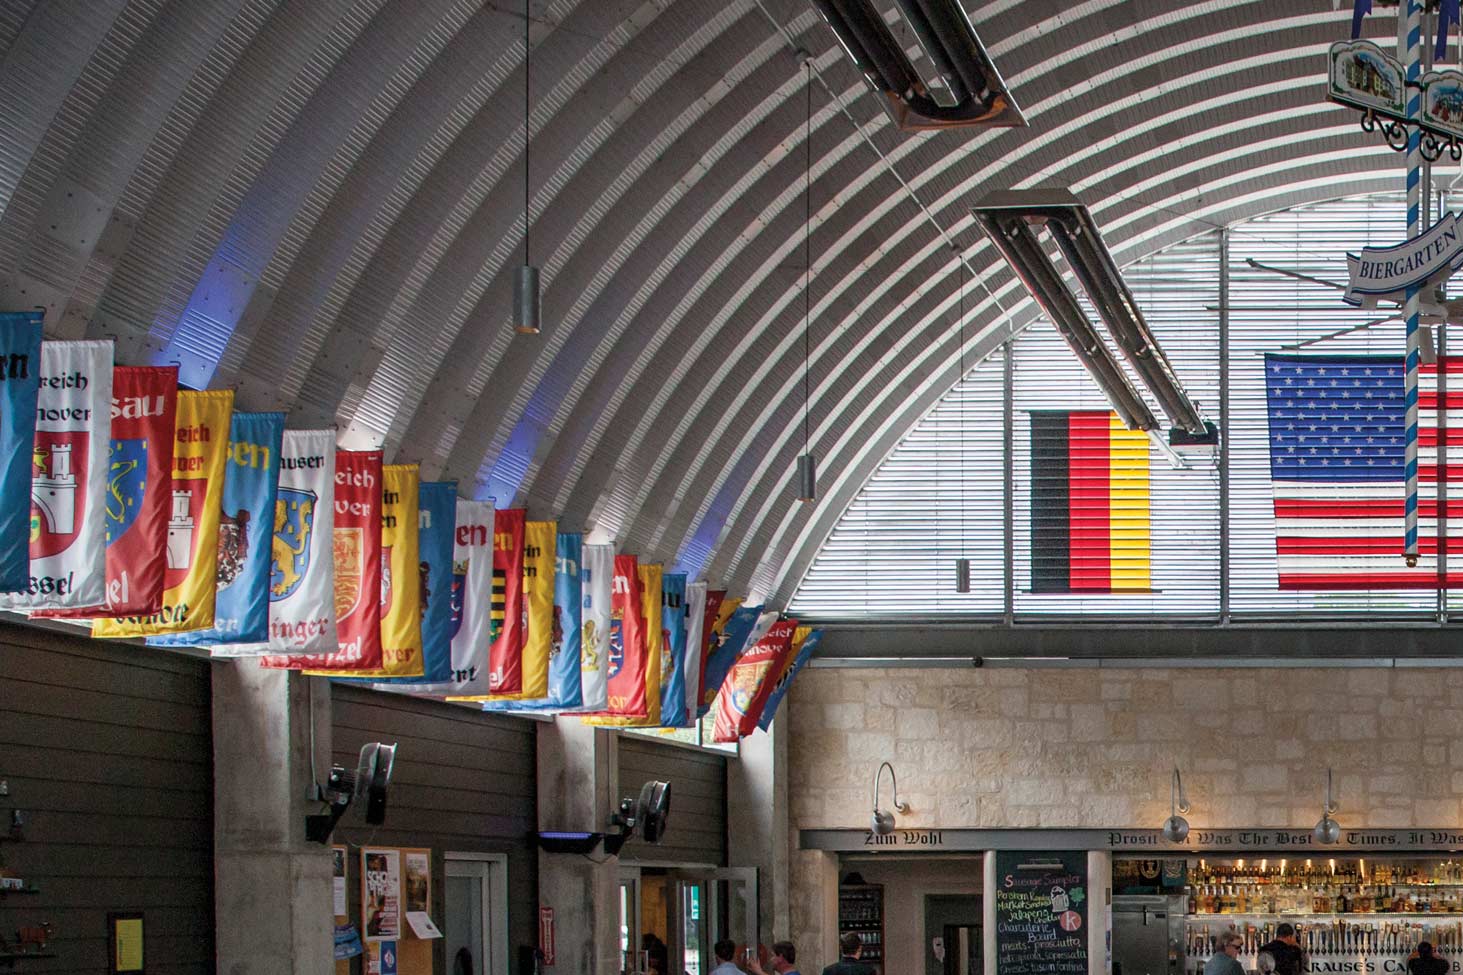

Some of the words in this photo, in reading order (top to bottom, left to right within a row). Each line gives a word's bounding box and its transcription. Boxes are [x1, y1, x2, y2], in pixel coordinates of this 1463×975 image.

[1359, 226, 1456, 279] BIERGARTEN
[864, 832, 898, 846] Zum
[903, 831, 944, 846] Wohl
[1197, 832, 1232, 845] Was
[1239, 832, 1269, 846] The
[1276, 832, 1312, 844] Best
[1408, 832, 1424, 844] It
